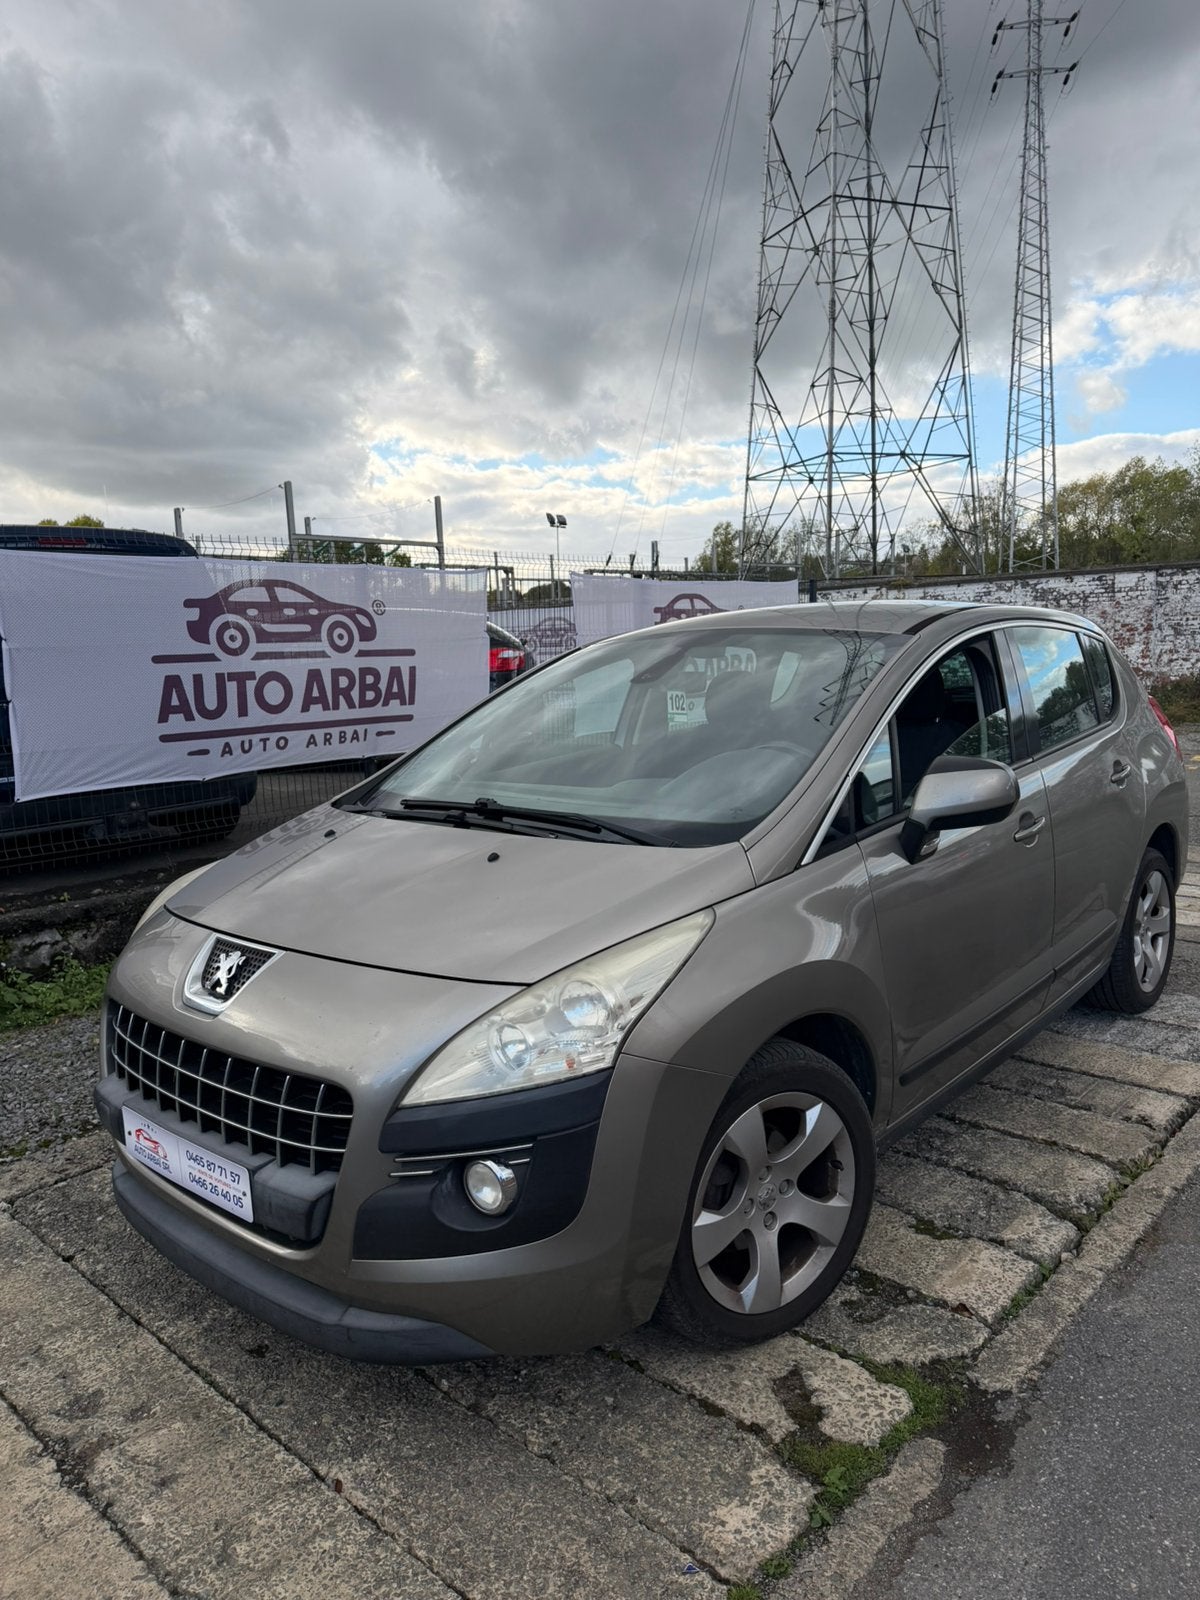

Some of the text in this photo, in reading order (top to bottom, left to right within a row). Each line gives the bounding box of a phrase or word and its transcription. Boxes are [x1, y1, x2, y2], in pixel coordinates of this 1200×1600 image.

[157, 665, 417, 724] AUTO ARBAI
[669, 694, 686, 711] 102
[220, 727, 369, 758] AUTO ARBAI
[185, 1149, 241, 1186] 0465 87 71 57
[188, 1171, 244, 1209] 0466 26 40 05
